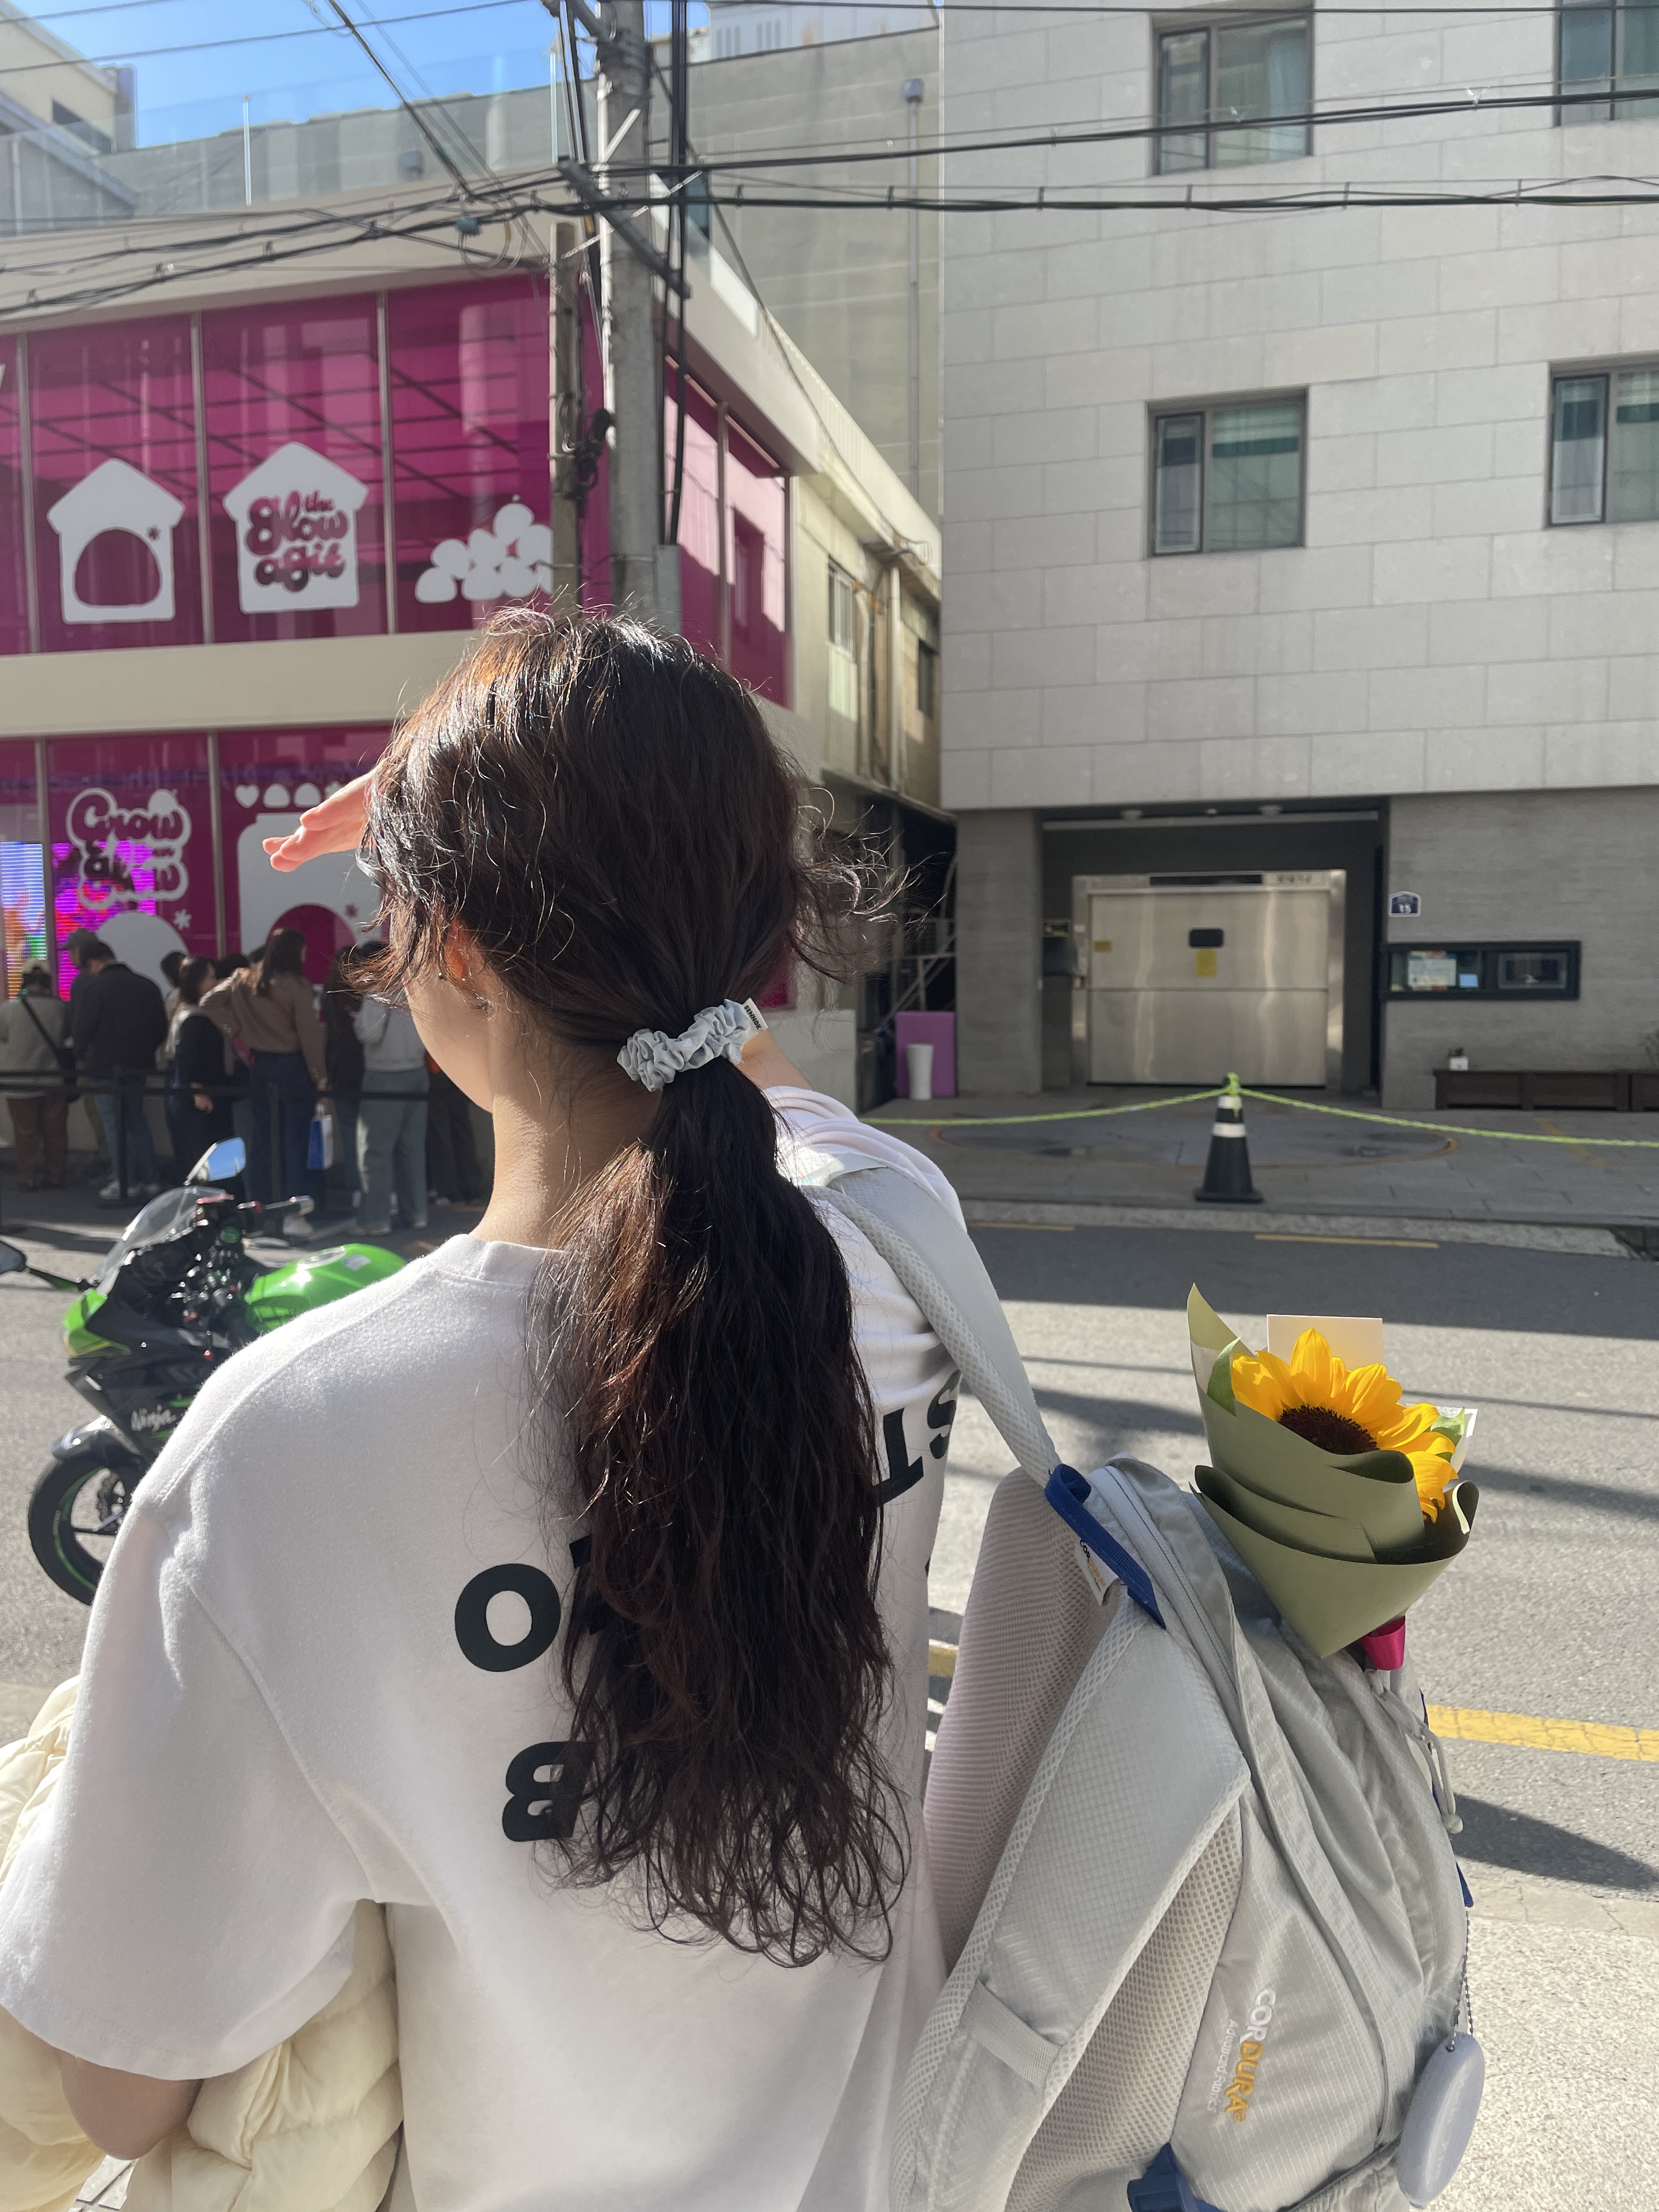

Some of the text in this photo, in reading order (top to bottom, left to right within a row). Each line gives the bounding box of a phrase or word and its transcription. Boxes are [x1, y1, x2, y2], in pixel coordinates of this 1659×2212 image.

[255, 543, 346, 592] agit
[744, 1005, 762, 1030] SENNOK
[131, 1404, 177, 1432] Ninja
